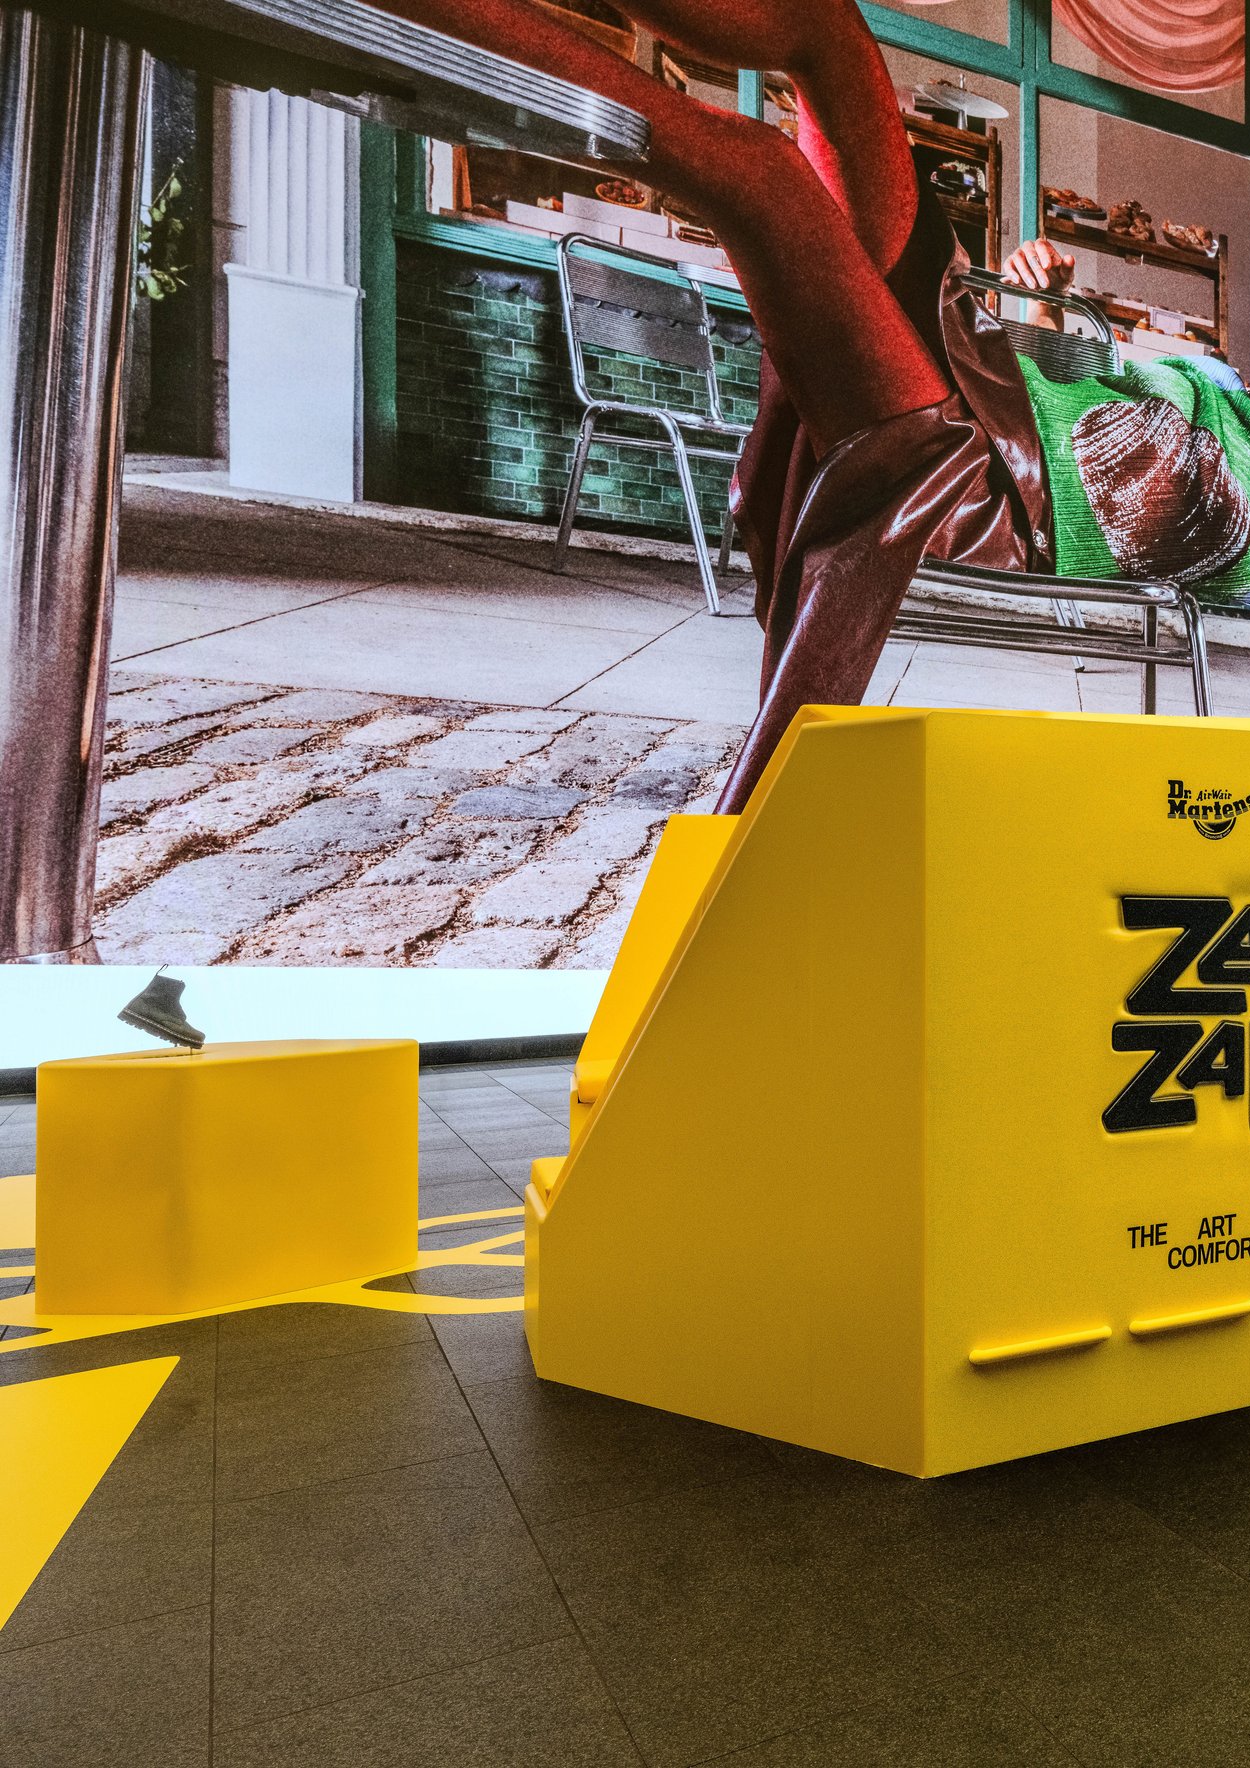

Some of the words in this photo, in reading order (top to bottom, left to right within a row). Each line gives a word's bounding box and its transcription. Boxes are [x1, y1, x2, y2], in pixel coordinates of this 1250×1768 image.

[1168, 780, 1192, 799] Dr.
[1196, 789, 1232, 802] AirWair
[1127, 1222, 1168, 1249] THE
[1197, 1213, 1237, 1240] ART
